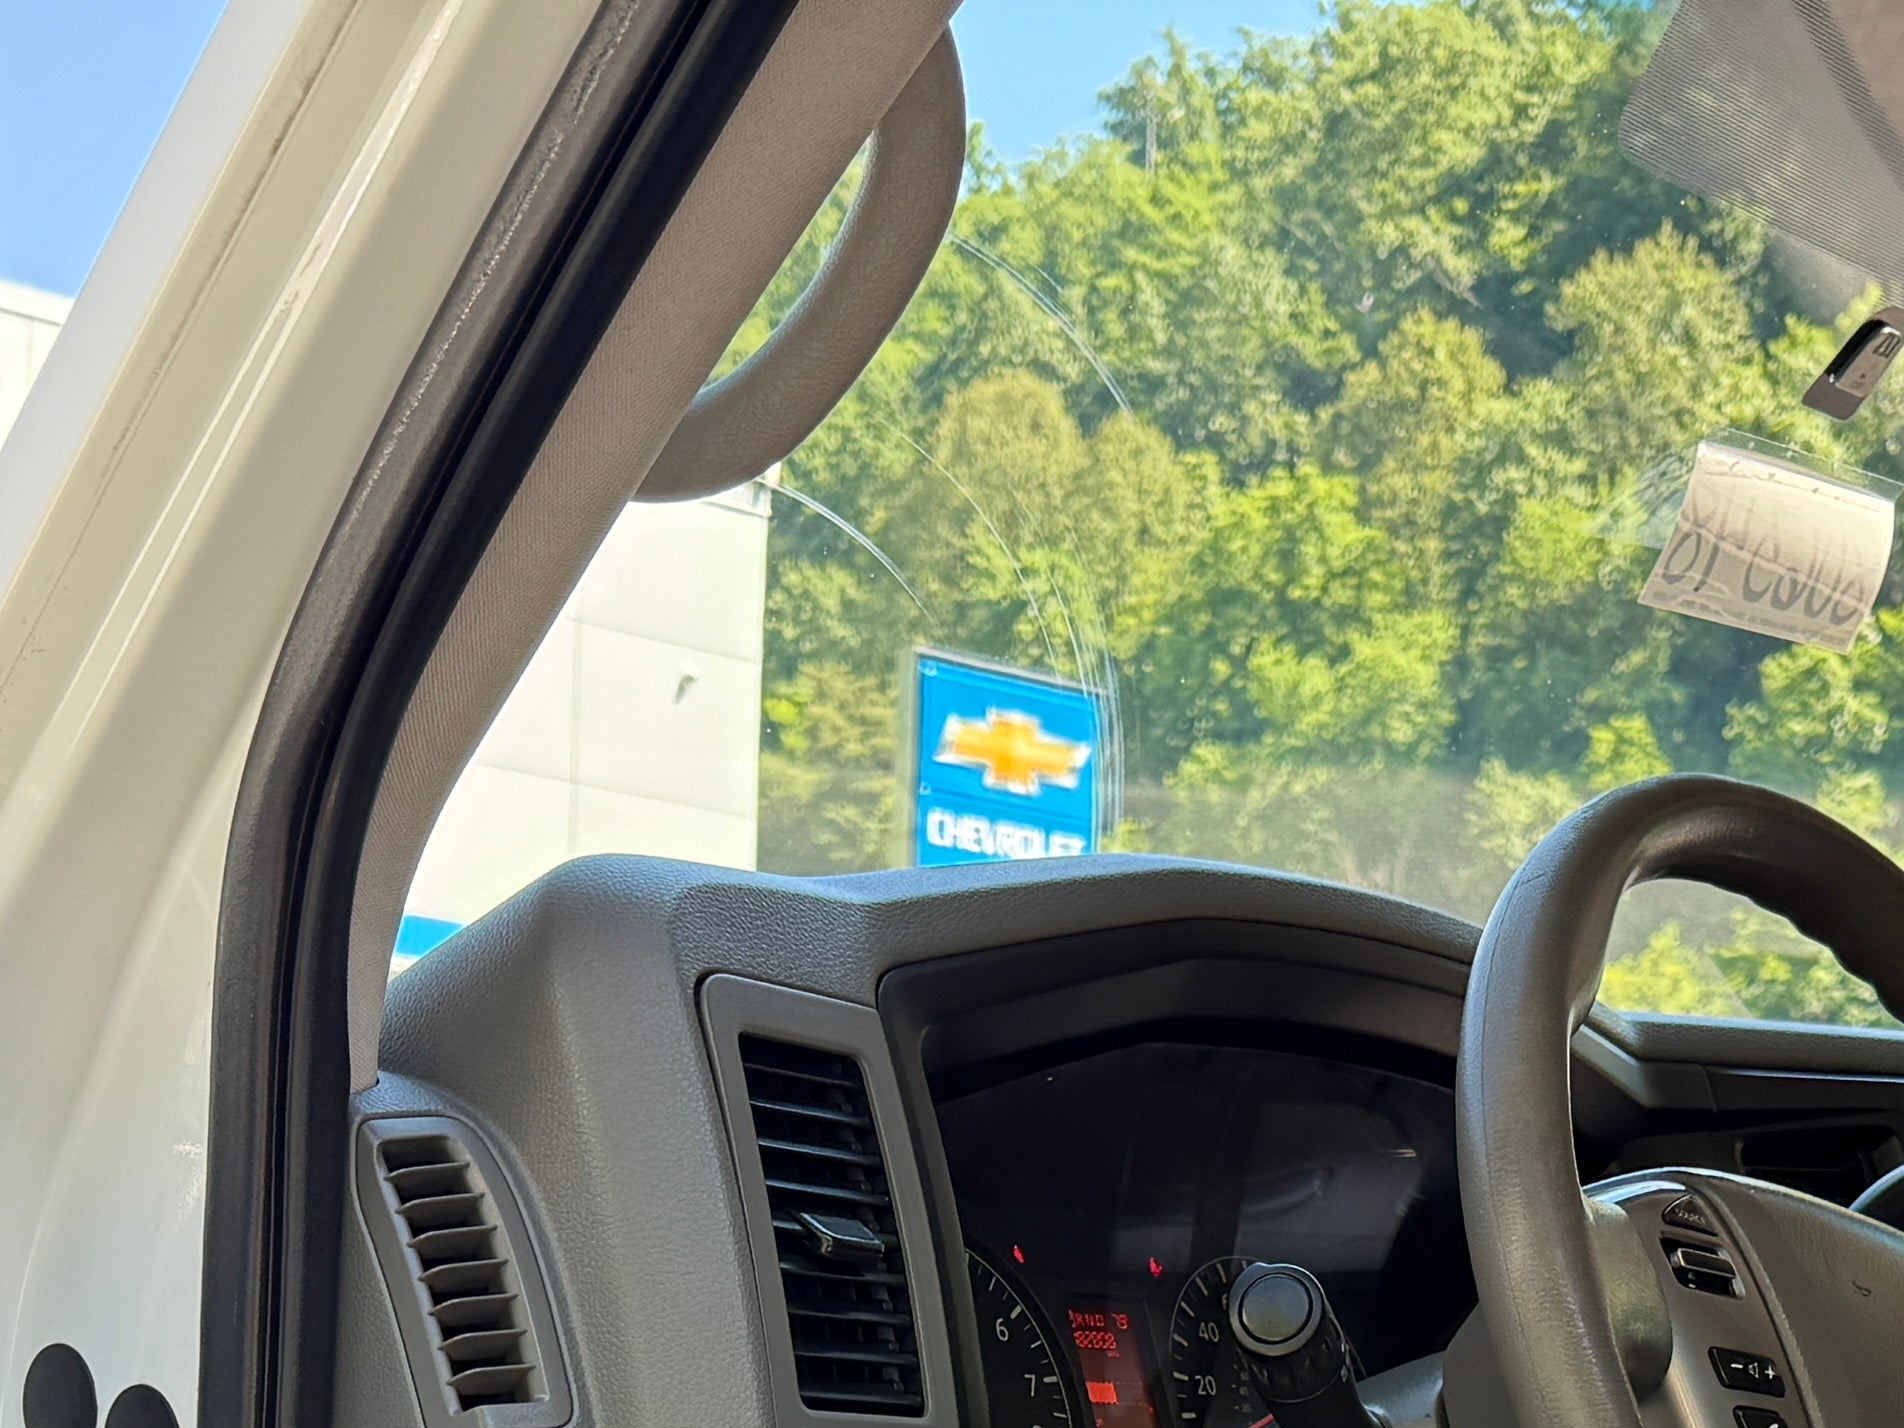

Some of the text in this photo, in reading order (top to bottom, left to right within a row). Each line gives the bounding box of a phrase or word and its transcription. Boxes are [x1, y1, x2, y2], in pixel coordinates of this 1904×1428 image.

[926, 806, 1086, 860] CHEVROLET
[996, 1317, 1009, 1342] 6
[1199, 1321, 1220, 1343] 40
[1024, 1373, 1036, 1397] 7
[1195, 1375, 1217, 1396] 20
